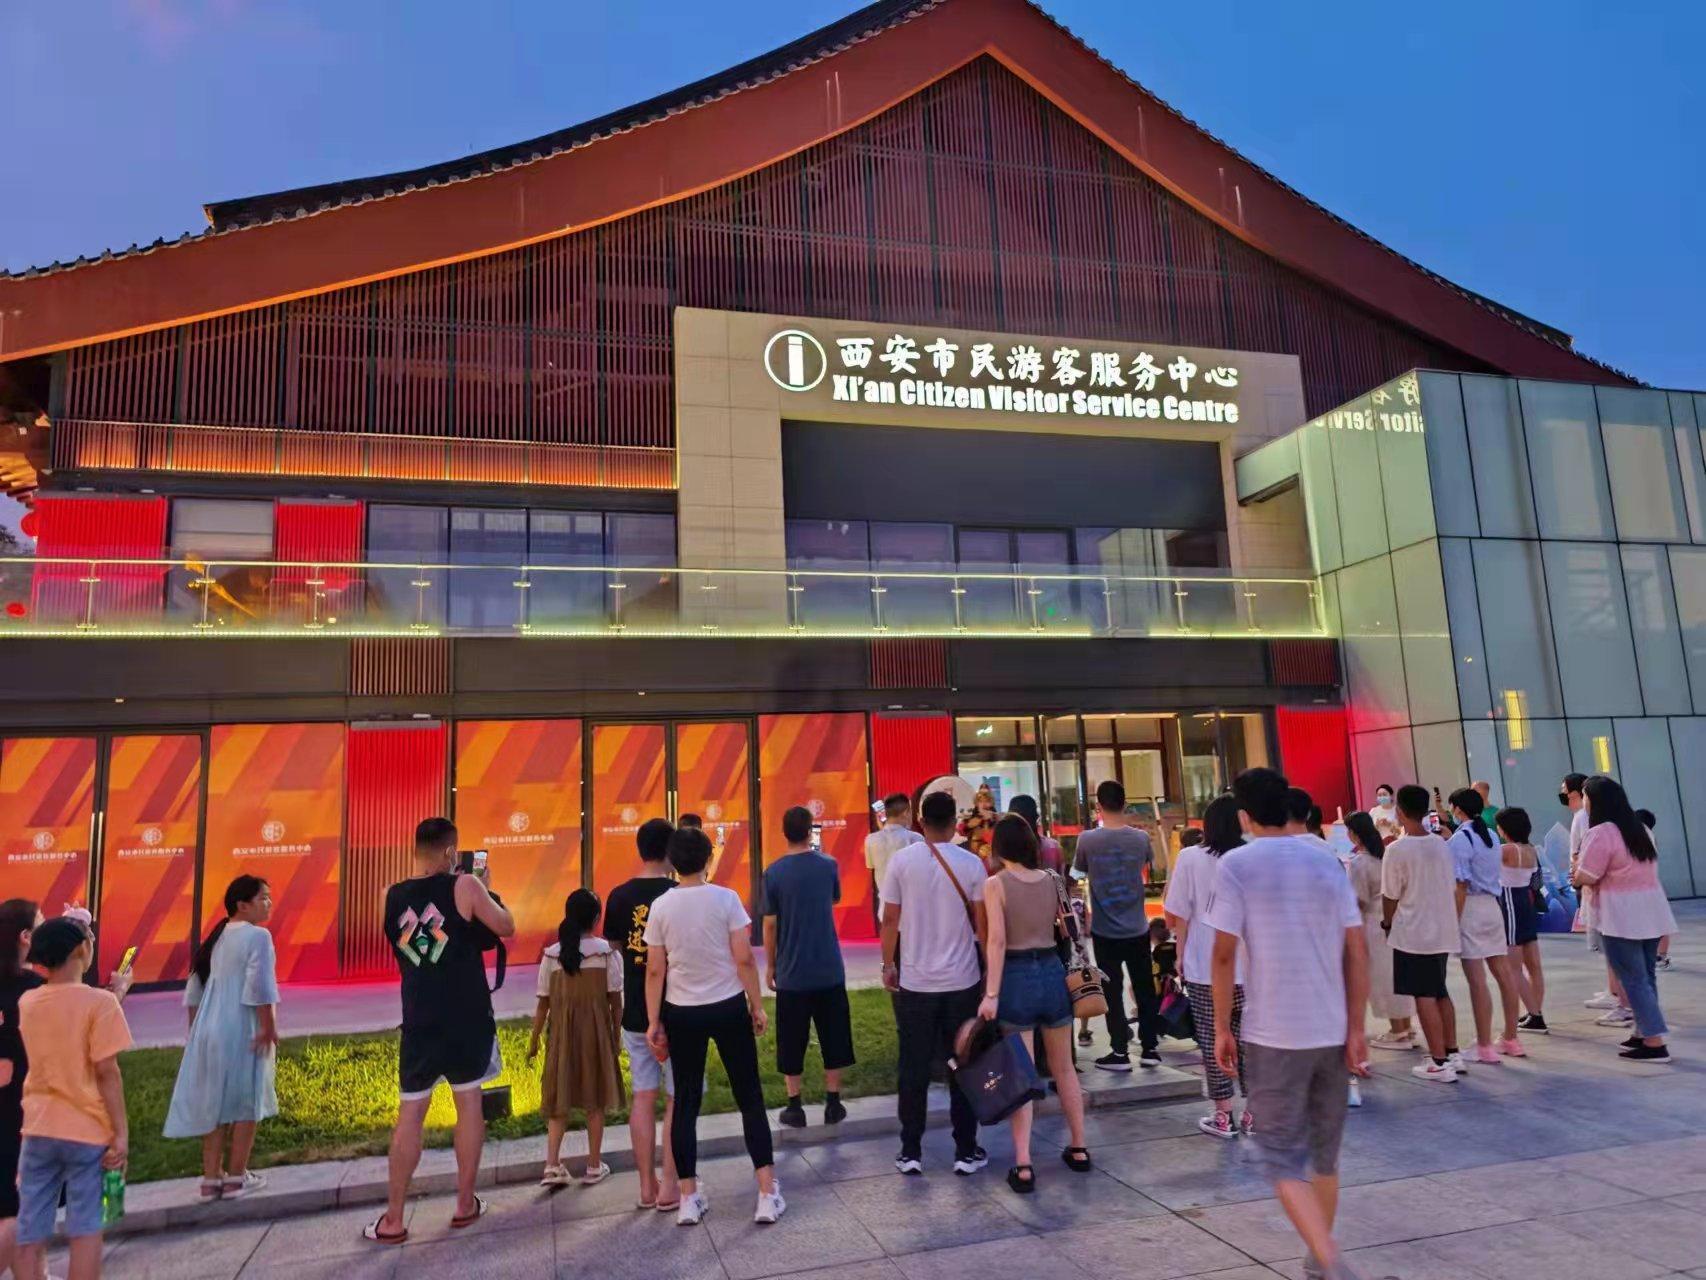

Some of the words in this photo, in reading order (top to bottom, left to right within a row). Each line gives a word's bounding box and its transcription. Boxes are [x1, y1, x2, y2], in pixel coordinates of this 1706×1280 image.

[836, 333, 1239, 394] 西安市民游客服务中心
[832, 374, 896, 404] Xi'an
[899, 378, 986, 410] Citizen
[987, 384, 1070, 414] Visitor
[1071, 389, 1161, 419] Service
[1162, 395, 1240, 424] Centre
